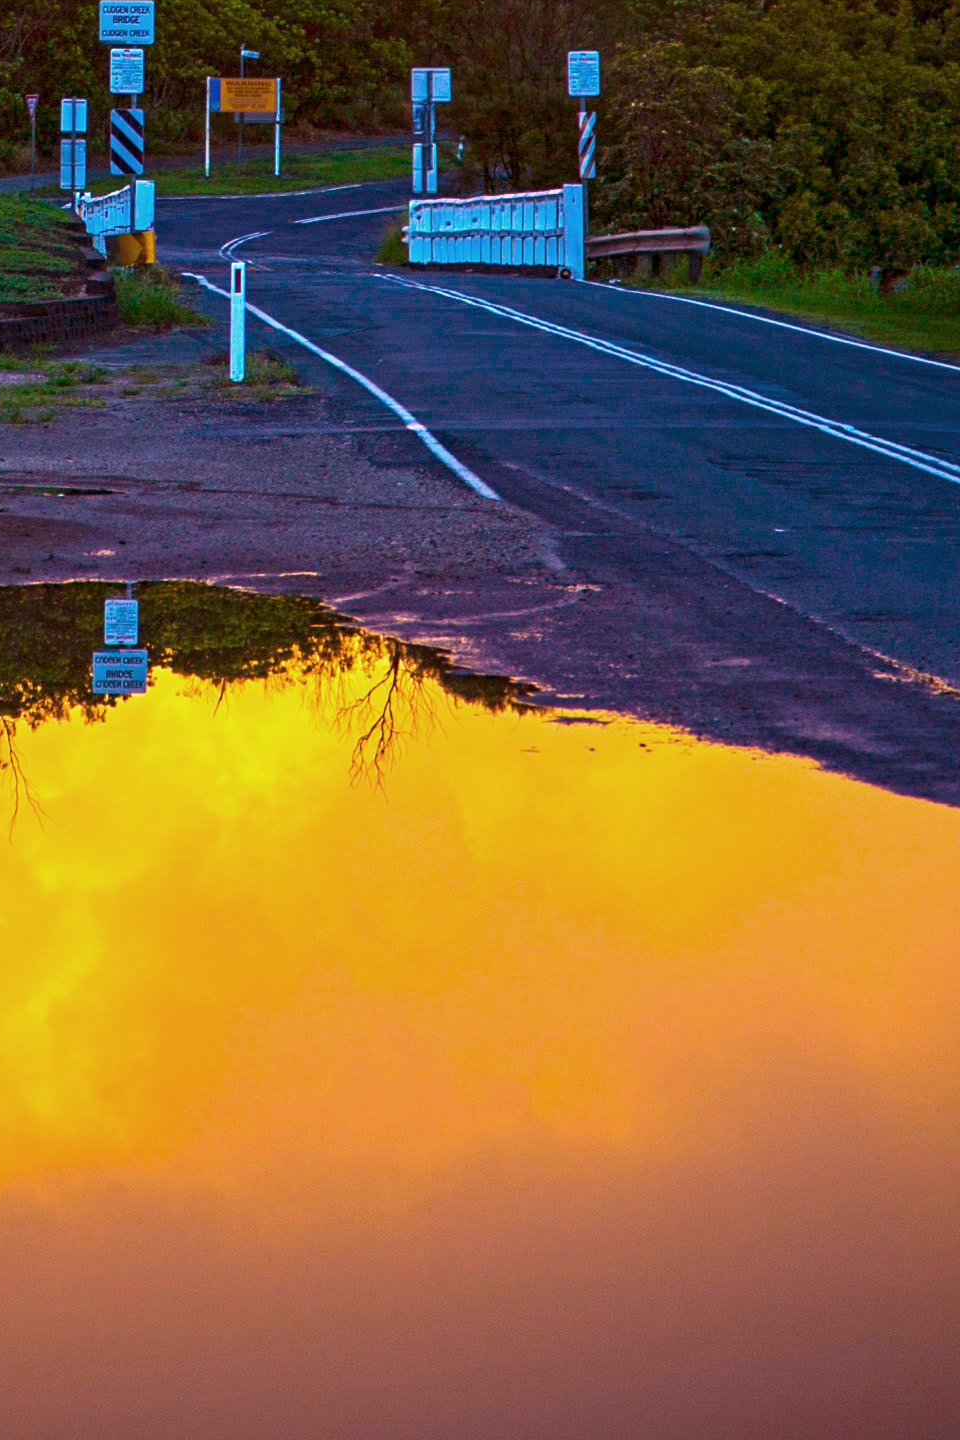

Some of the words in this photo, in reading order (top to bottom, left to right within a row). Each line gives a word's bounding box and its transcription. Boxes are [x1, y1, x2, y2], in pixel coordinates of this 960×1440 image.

[102, 6, 128, 14] CUDGEN
[130, 6, 151, 14] CREEK
[112, 15, 141, 24] BRIDGE
